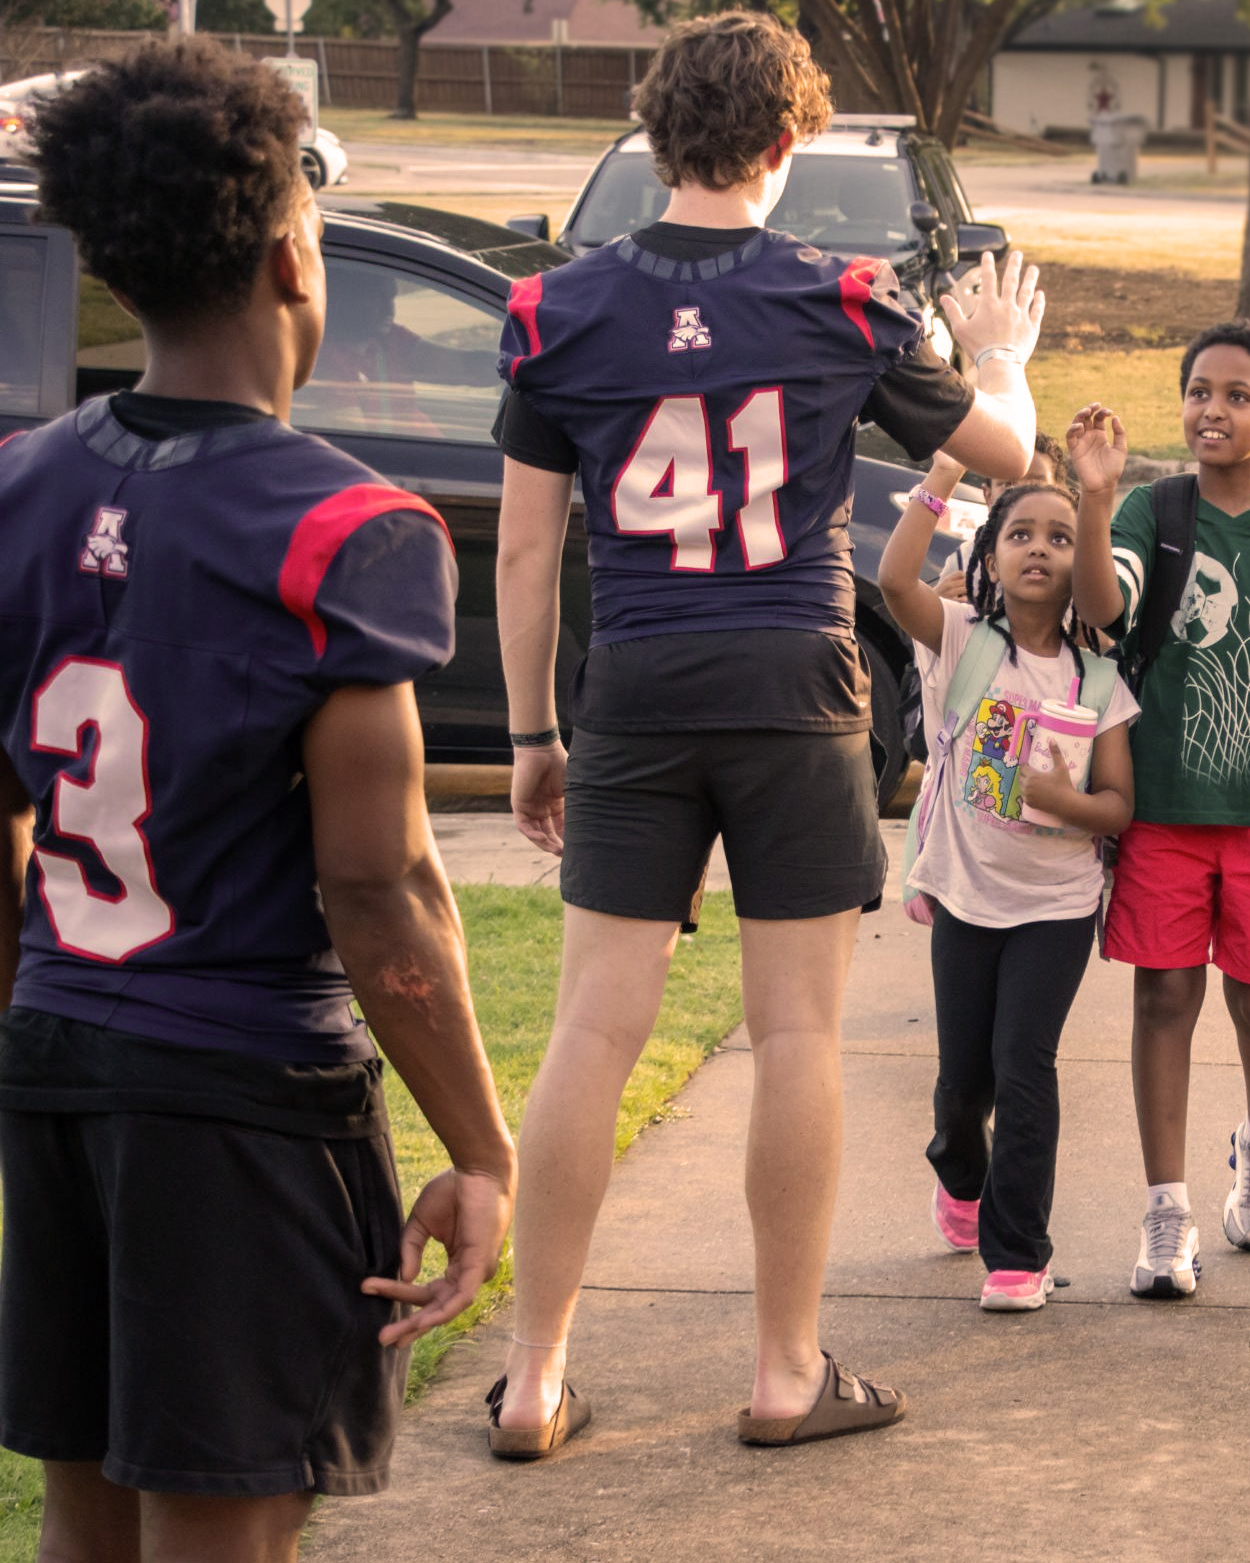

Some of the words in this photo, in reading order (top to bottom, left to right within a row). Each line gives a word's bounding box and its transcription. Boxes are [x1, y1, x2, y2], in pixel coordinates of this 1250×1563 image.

[668, 307, 711, 352] A
[78, 506, 129, 578] A
[611, 385, 789, 573] 41
[30, 654, 176, 965] 3
